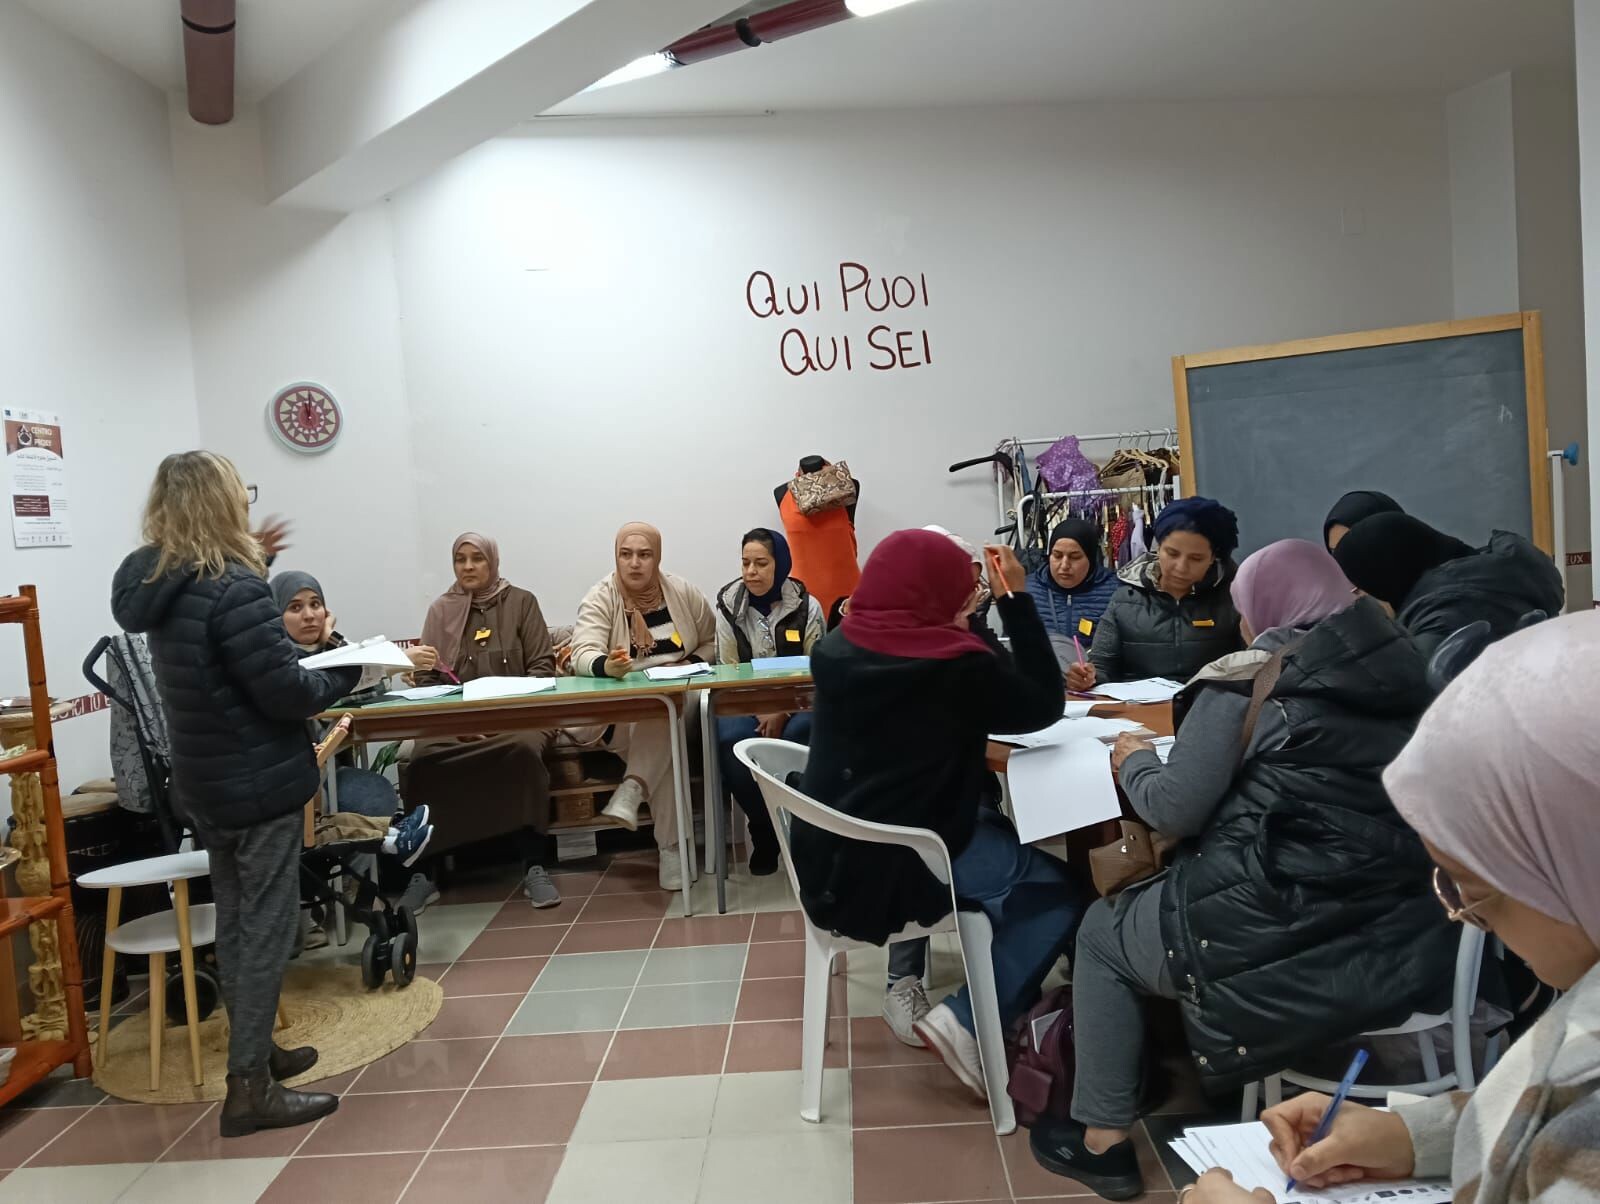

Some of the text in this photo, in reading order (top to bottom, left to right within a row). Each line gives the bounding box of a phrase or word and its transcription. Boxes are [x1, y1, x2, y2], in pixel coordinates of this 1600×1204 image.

[746, 262, 929, 318] QUI PUOI
[780, 325, 932, 376] QUI SEI
[88, 693, 101, 712] TU
